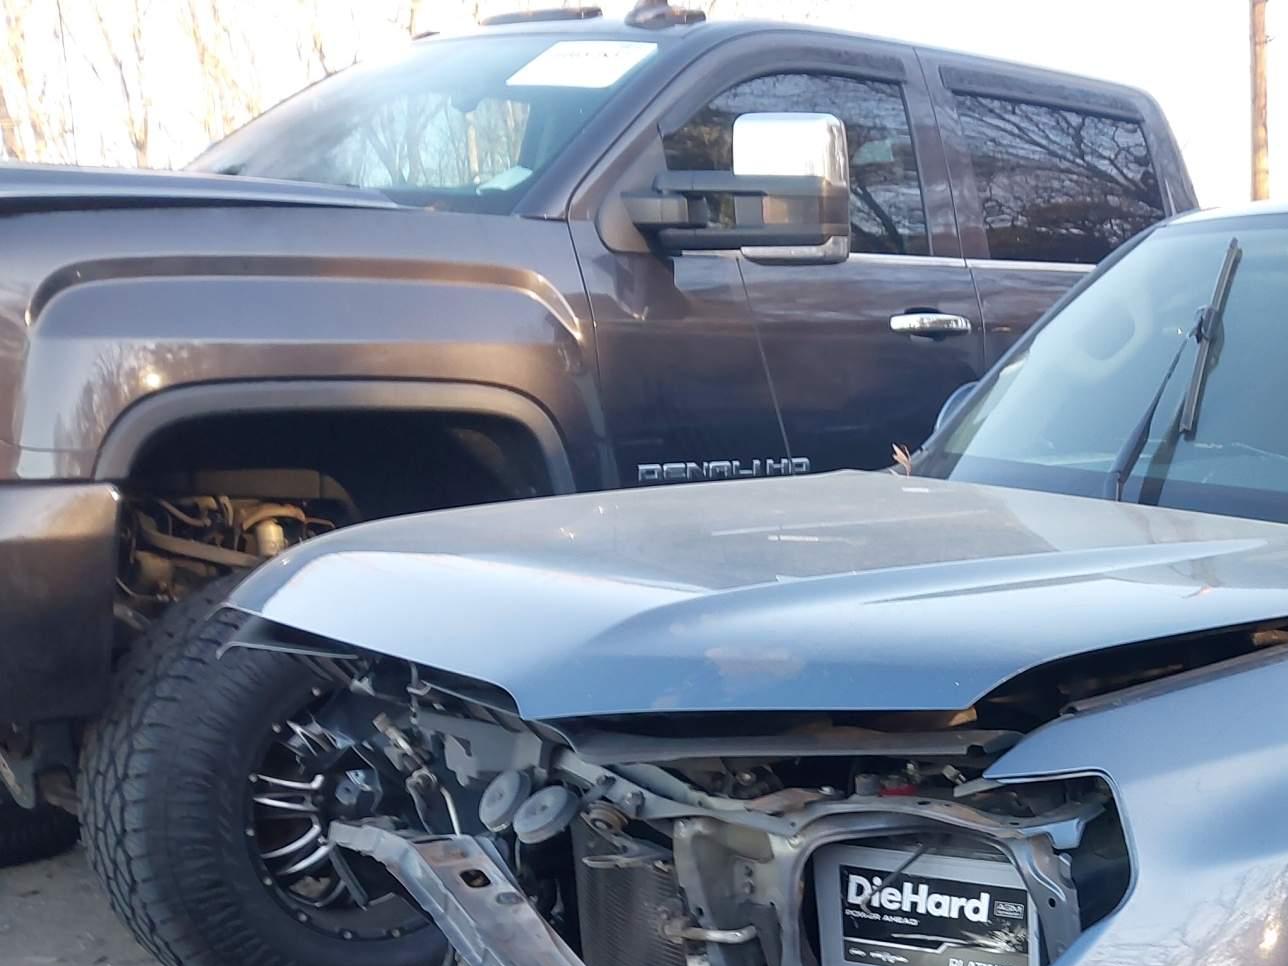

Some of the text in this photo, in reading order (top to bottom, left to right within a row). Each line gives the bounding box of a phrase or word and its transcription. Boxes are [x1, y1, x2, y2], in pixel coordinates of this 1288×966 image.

[638, 457, 811, 480] DENALI HD
[848, 874, 991, 923] DieHard
[845, 909, 919, 926] POWER AHEAD
